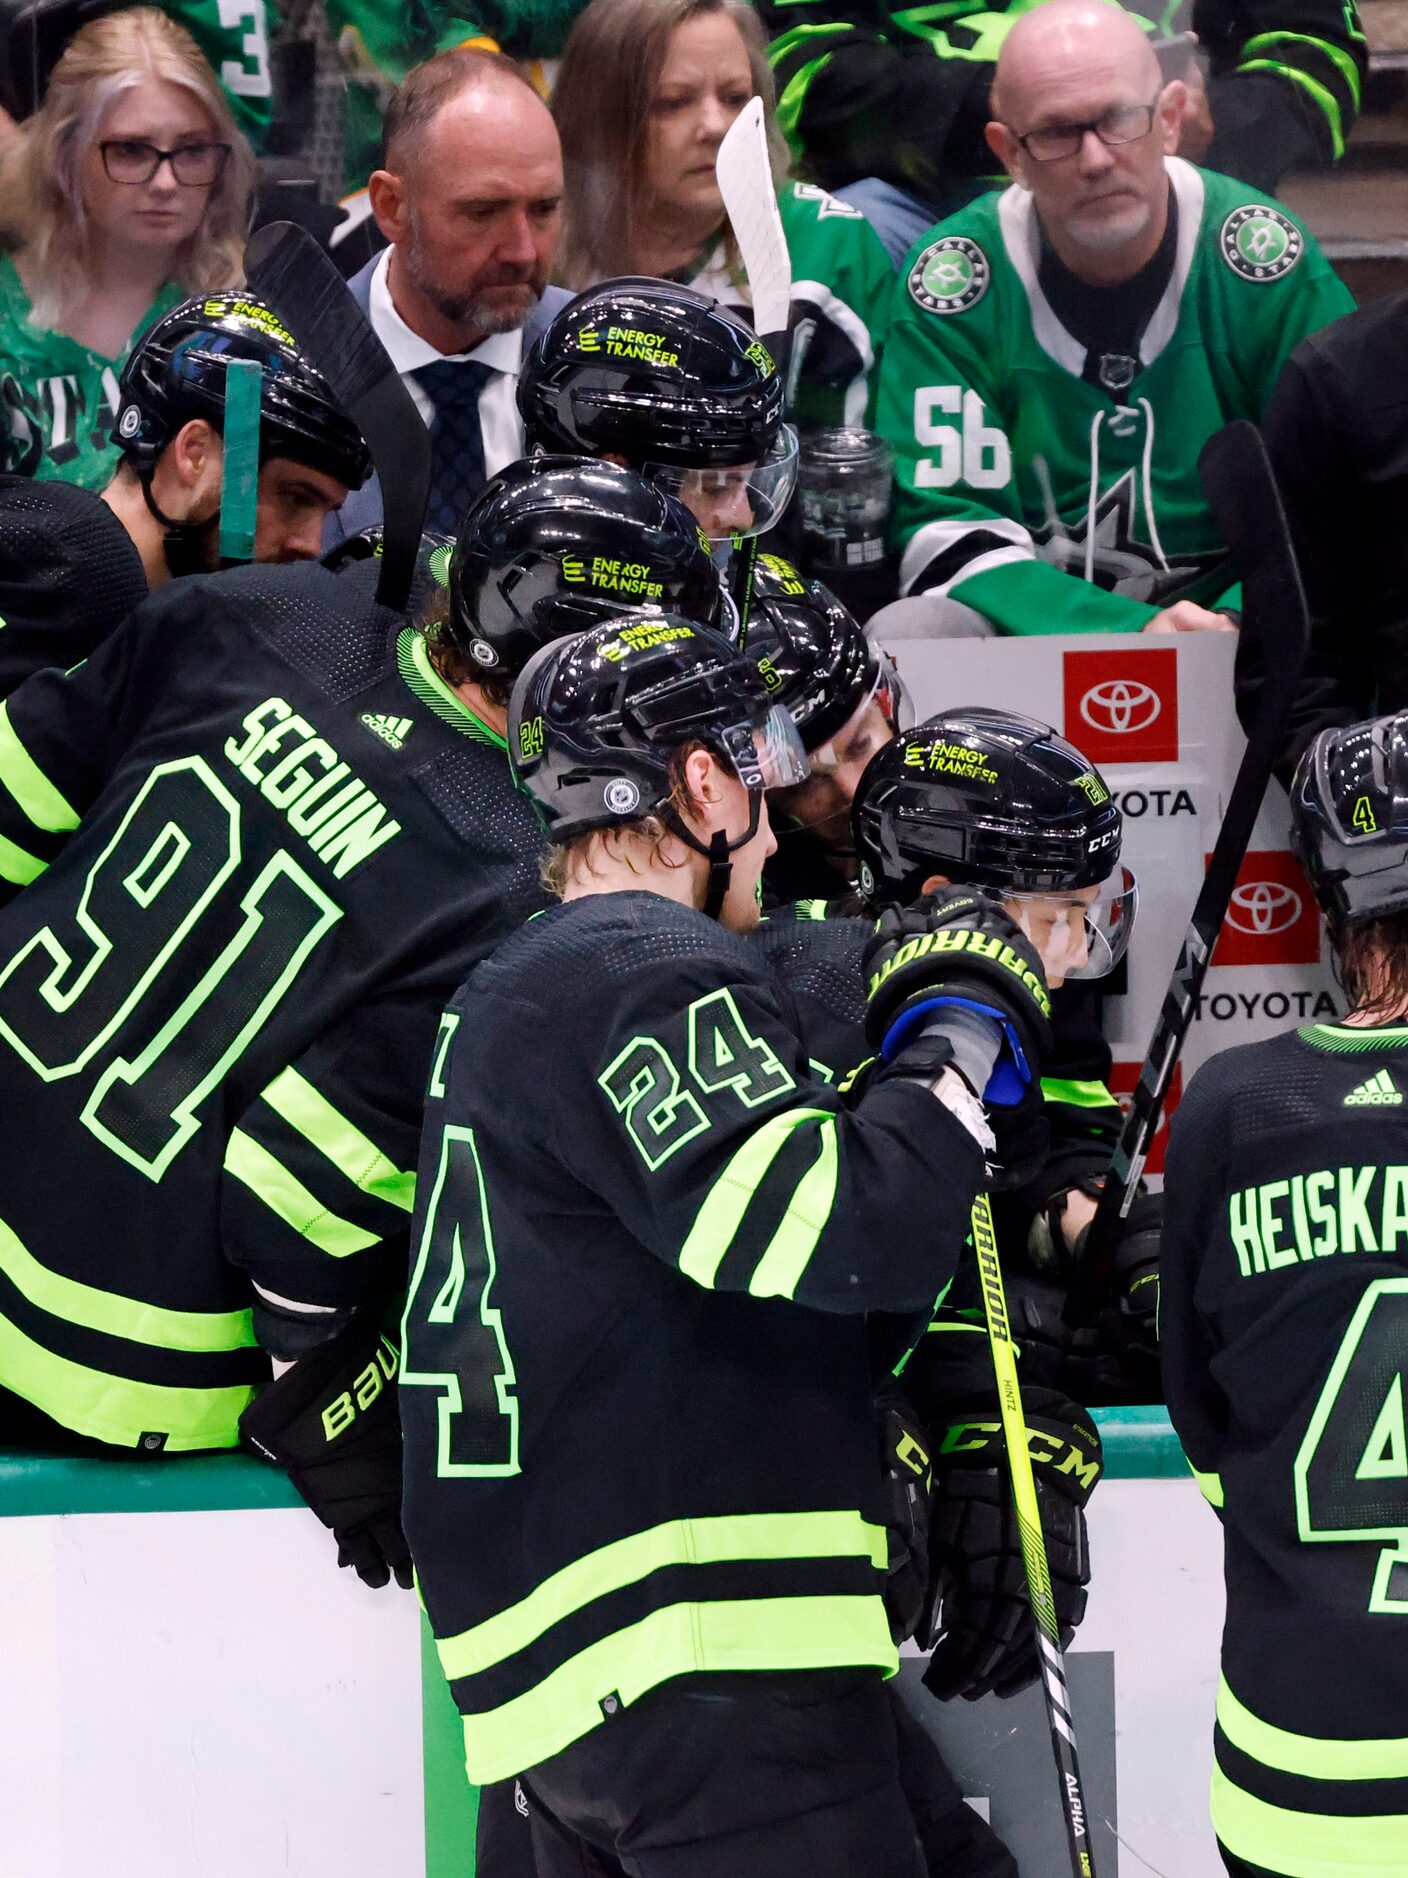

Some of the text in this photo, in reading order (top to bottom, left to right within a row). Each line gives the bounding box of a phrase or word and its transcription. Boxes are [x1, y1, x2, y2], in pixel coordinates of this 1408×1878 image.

[604, 341, 679, 368] TRANSFER
[606, 326, 667, 348] ENERGY
[914, 384, 1012, 490] 56
[591, 557, 651, 578] ENERGY
[591, 573, 664, 598] TRANSFER
[627, 627, 696, 651] TRANSFER
[361, 714, 404, 750] adidas
[519, 716, 544, 760] 24
[928, 755, 999, 785] TRANSFER
[930, 743, 989, 766] ENERGY
[225, 697, 402, 880] SEGUIN
[1353, 796, 1377, 833] 4
[0, 754, 345, 1184] 91
[597, 985, 798, 1173] 24
[1343, 1091, 1404, 1105] adidas
[973, 1195, 1010, 1343] ARRIOR
[1003, 1379, 1018, 1412] HINTZ
[939, 1422, 1100, 1490] CCM
[1064, 1771, 1087, 1838] ALPHA
